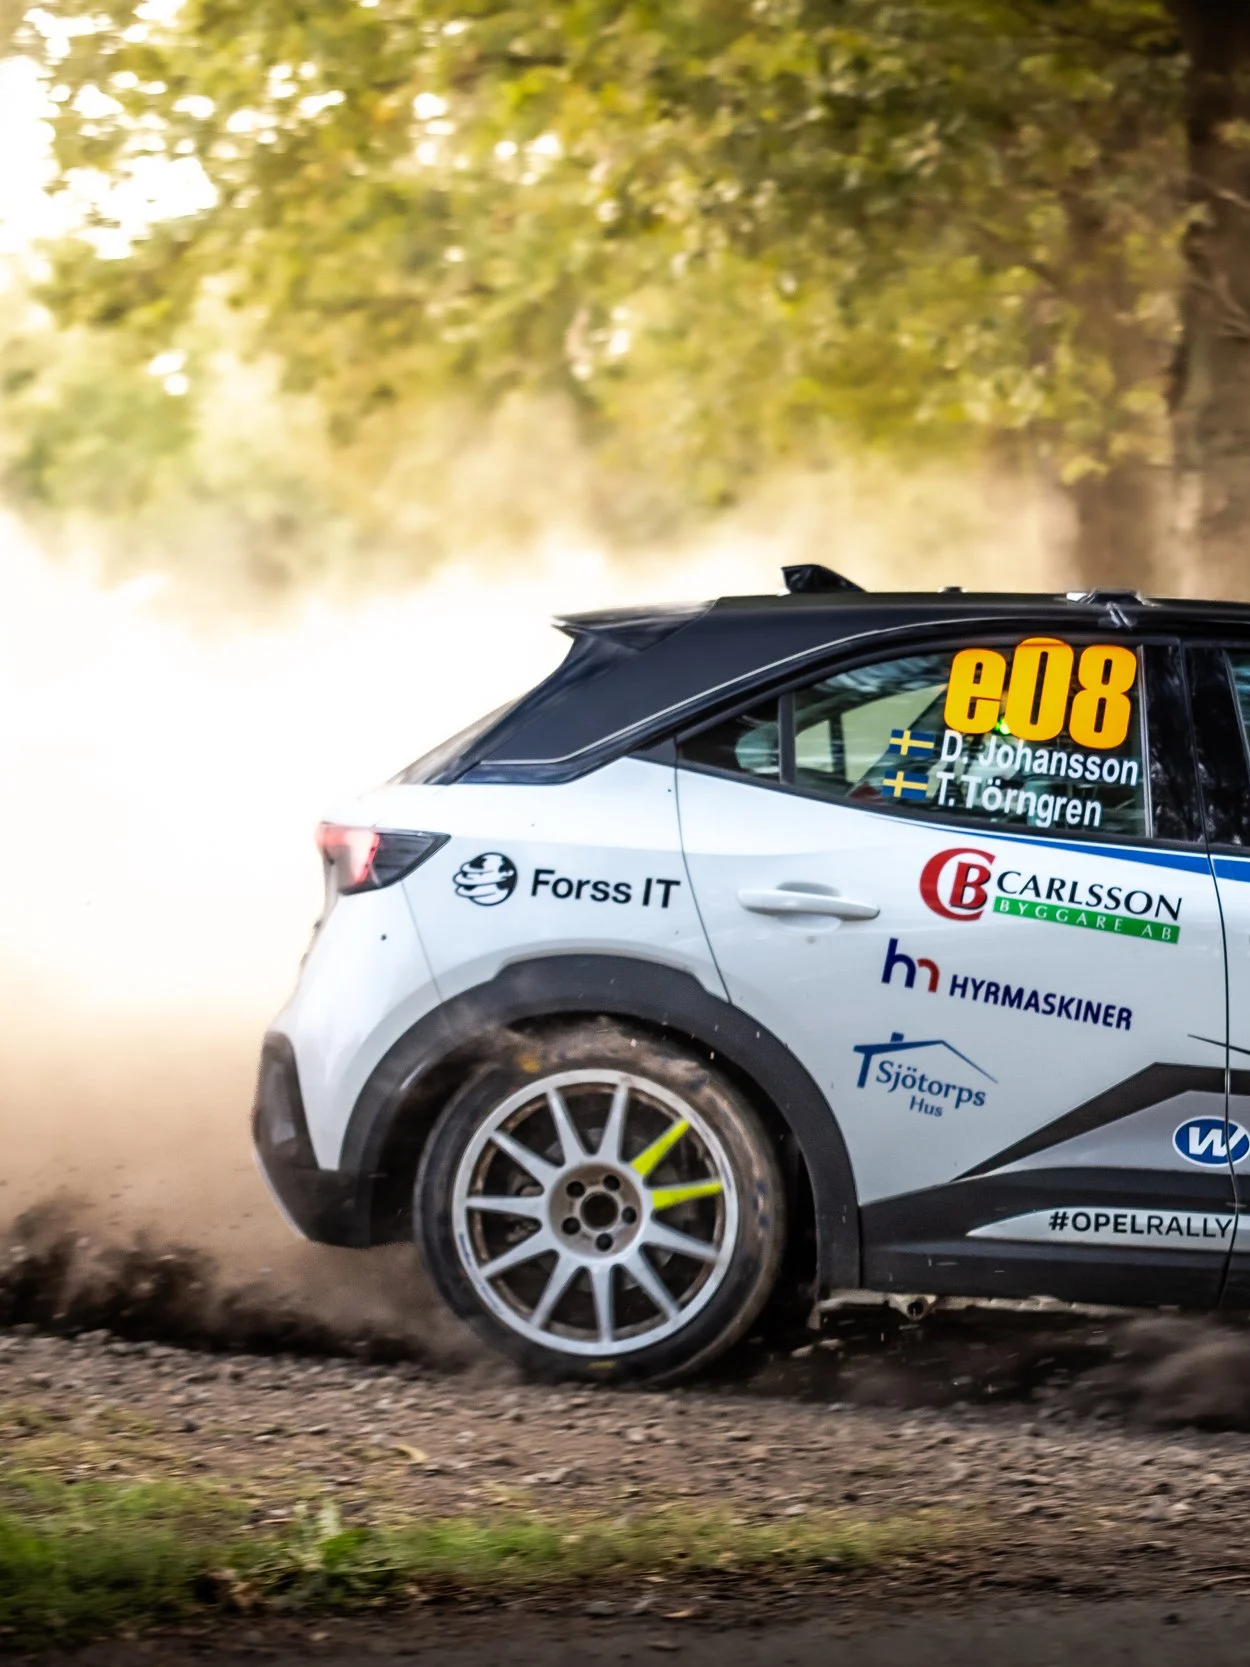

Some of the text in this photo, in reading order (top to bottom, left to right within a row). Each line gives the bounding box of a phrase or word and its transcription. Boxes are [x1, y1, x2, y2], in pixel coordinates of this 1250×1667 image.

[944, 637, 1137, 749] e08
[941, 730, 1138, 786] D. Johansson
[936, 772, 1101, 828] T. Törngren
[531, 868, 681, 908] Forss IT
[996, 870, 1183, 921] CARLSSON
[1000, 900, 1171, 940] BYGGARE AB
[949, 974, 1133, 1031] HYRMASKINER
[876, 1060, 987, 1109] Sjötorps
[909, 1096, 943, 1117] Hus
[1049, 1211, 1233, 1239] #OPELRALLY
